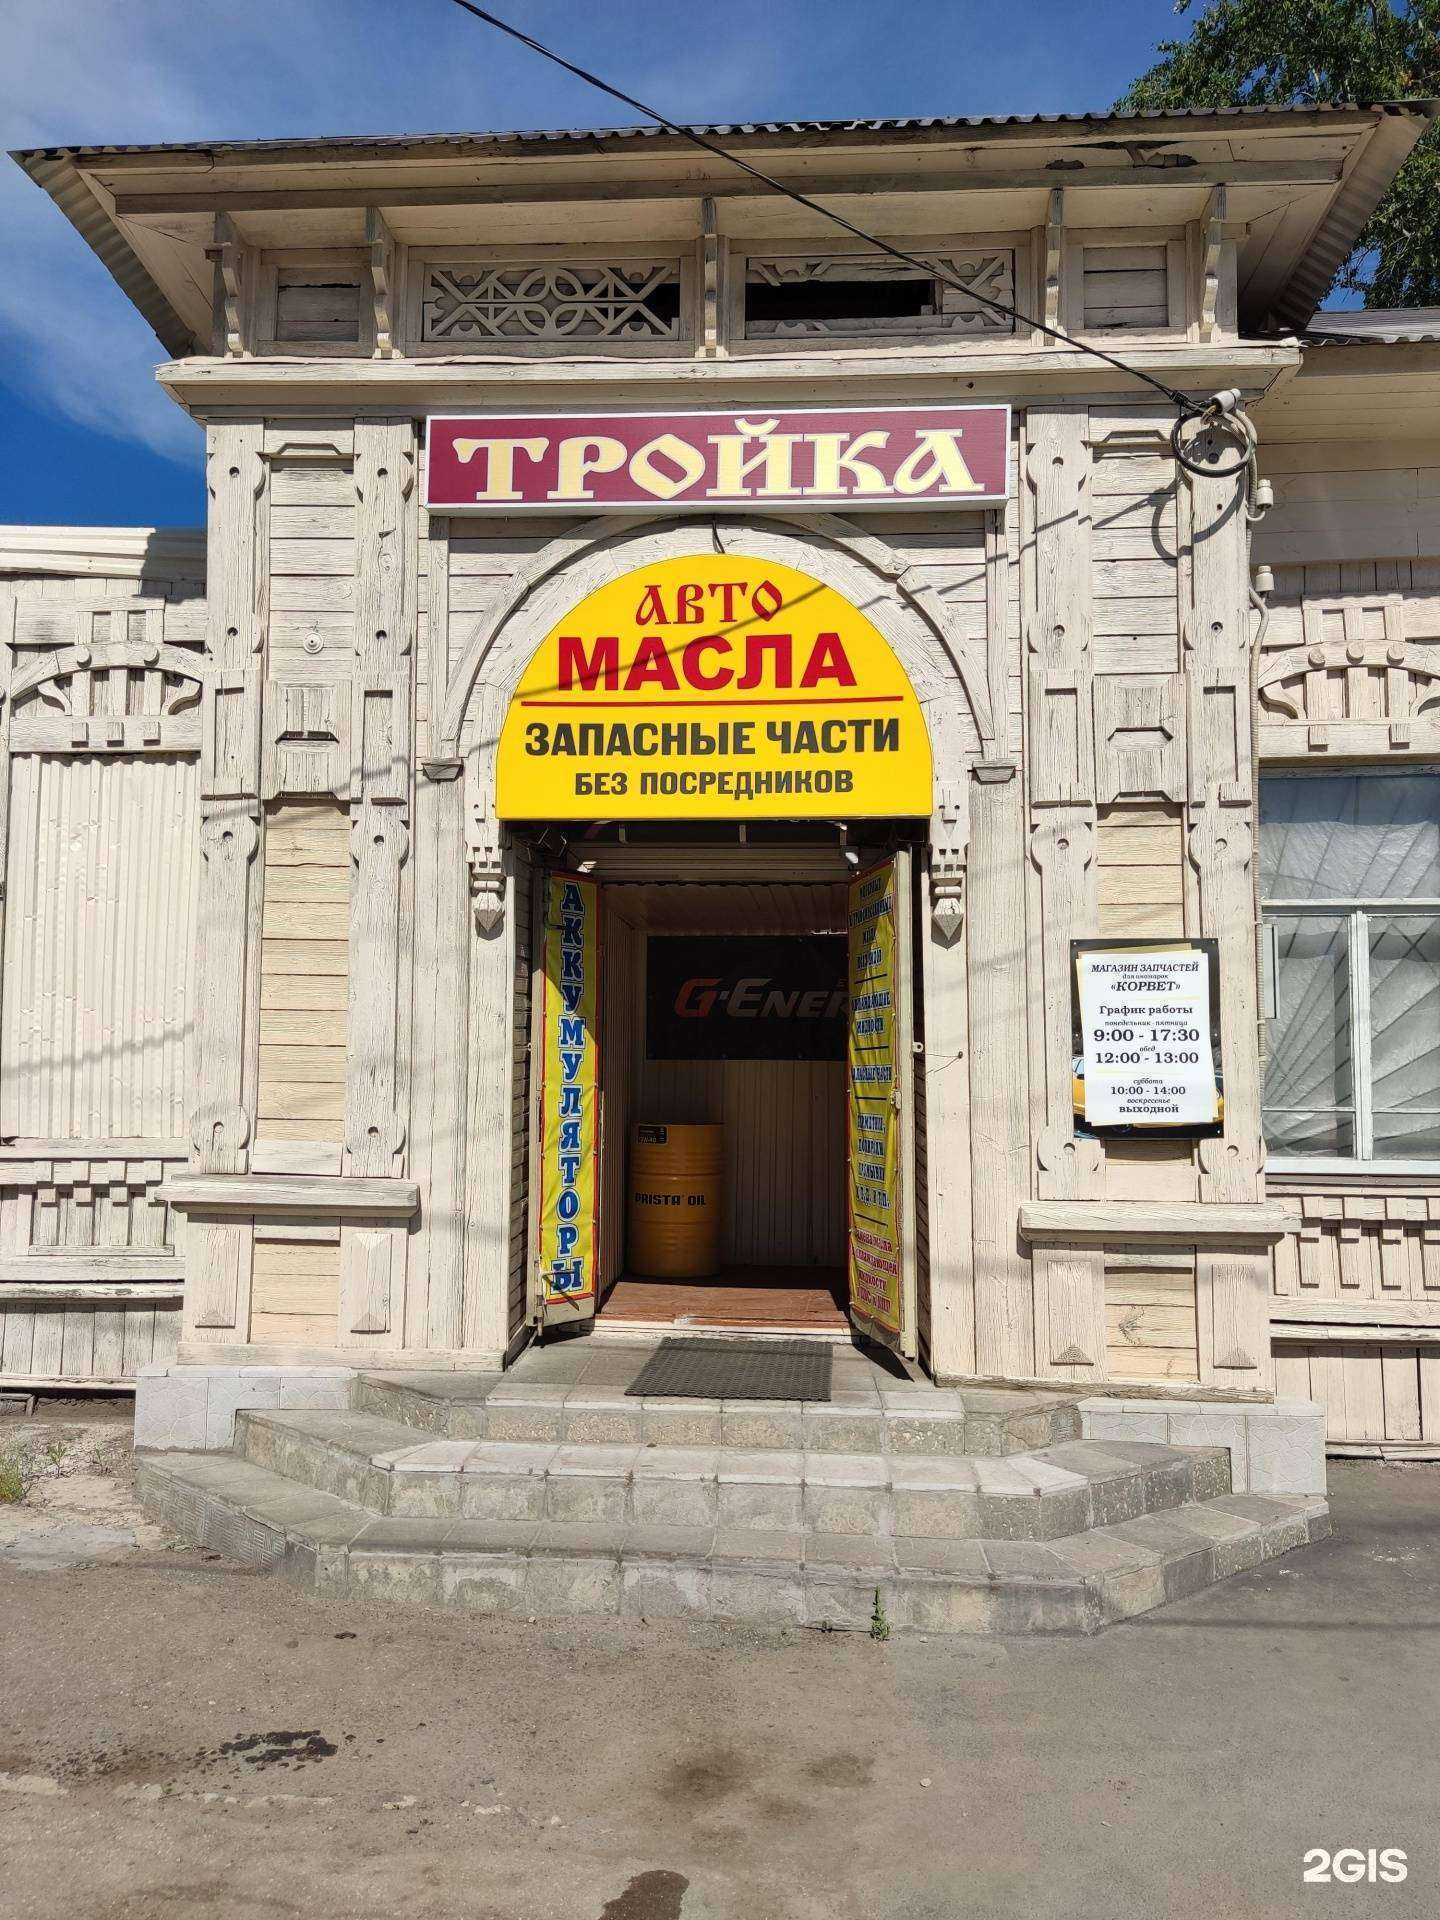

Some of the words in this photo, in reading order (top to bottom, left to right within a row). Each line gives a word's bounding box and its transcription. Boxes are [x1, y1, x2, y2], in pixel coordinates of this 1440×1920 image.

[452, 417, 985, 501] ТРОЙКА
[635, 579, 783, 626] АВТО
[558, 632, 858, 691] МАСЛА
[525, 721, 756, 756] ЗАПАСНЫЕ
[766, 717, 900, 754] ЧАСТИ
[575, 772, 628, 796] БЕЗ
[640, 769, 854, 801] ПОСРЕДНИКОВ
[1091, 964, 1138, 973] МАГАЗИН
[1140, 961, 1200, 972] ЗАПЧАСТЕЙ
[1111, 981, 1181, 992] «КОРВЕТ»
[1099, 1005, 1146, 1016] График
[1149, 1004, 1194, 1016] работы
[1155, 1020, 1188, 1028] пятница
[1093, 1028, 1134, 1042] 9:00
[1150, 1028, 1200, 1042] 17:30
[1095, 1052, 1141, 1064] 12:00
[1155, 1052, 1199, 1064] 13:00
[550, 882, 587, 1295] АККУМУЛЯТОРЫ
[1111, 1086, 1143, 1095] 10:00
[1153, 1086, 1186, 1095] 14:00
[1119, 1104, 1180, 1114] выходной
[687, 1195, 707, 1206] OIL
